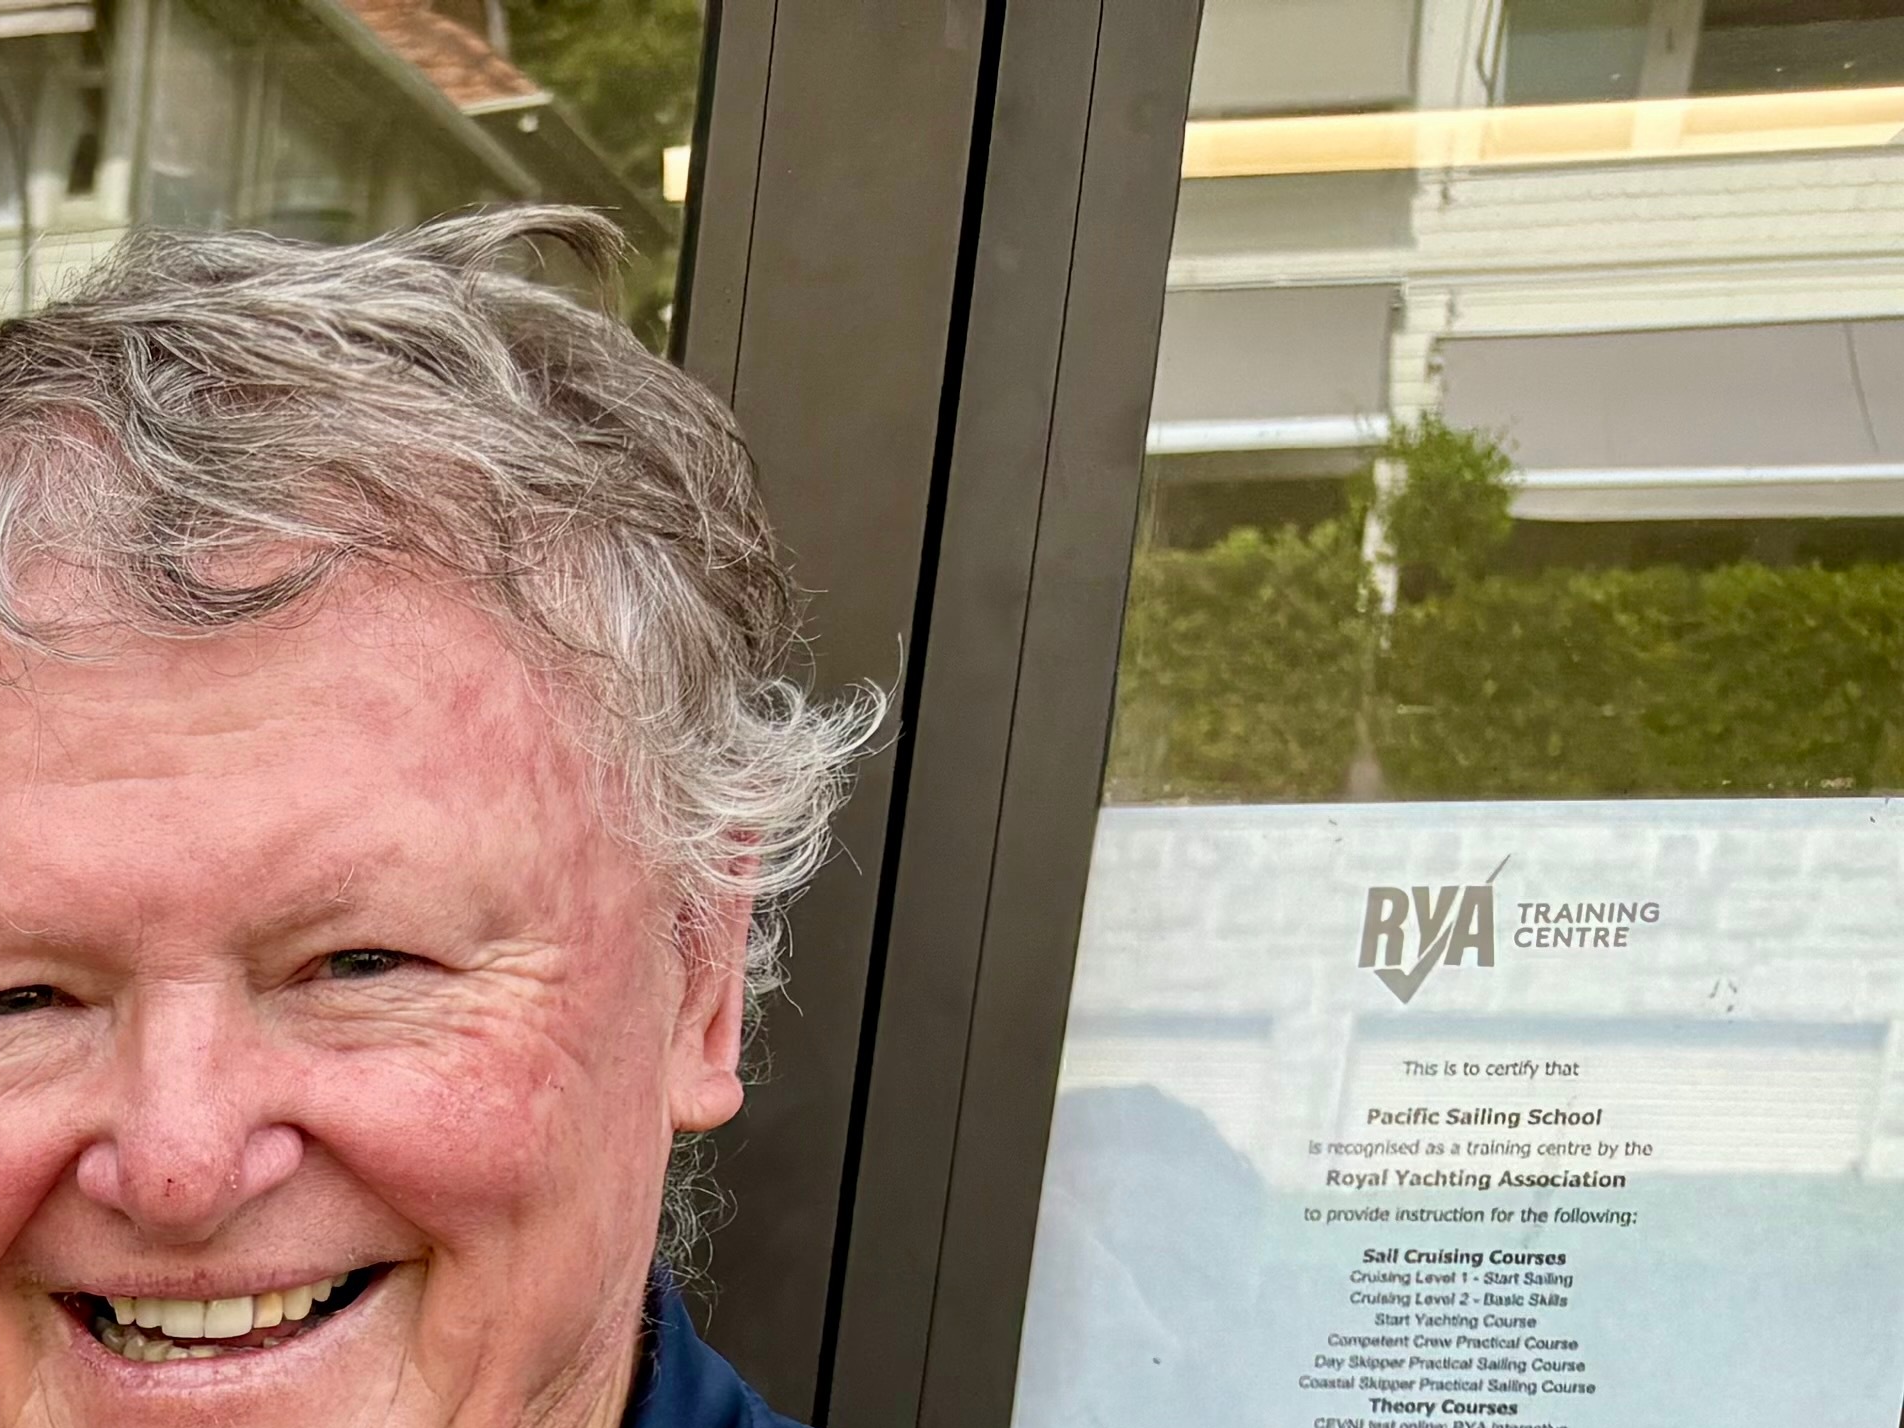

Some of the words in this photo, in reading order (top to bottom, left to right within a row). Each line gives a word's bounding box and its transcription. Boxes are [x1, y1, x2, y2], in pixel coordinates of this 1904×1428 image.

[1358, 868, 1502, 1000] RYA
[1517, 901, 1661, 926] TRAINING
[1513, 926, 1629, 949] CENTRE
[1402, 1060, 1438, 1077] This
[1444, 1060, 1457, 1077] is
[1463, 1062, 1480, 1077] to
[1485, 1060, 1539, 1080] certify
[1545, 1060, 1581, 1077] that
[1366, 1107, 1440, 1126] Pacific
[1445, 1107, 1522, 1130] Sailing
[1527, 1107, 1603, 1127] School
[1308, 1139, 1322, 1155] is
[1327, 1138, 1420, 1159] recognised
[1424, 1143, 1446, 1156] as
[1450, 1144, 1461, 1156] a
[1466, 1140, 1532, 1160] training
[1536, 1141, 1593, 1157] centre
[1596, 1141, 1619, 1160] by
[1624, 1140, 1654, 1157] the
[1325, 1168, 1389, 1191] Royal
[1394, 1168, 1492, 1192] Yachting
[1497, 1169, 1628, 1189] Association
[1304, 1206, 1322, 1222] to
[1325, 1205, 1390, 1226] provide
[1394, 1206, 1485, 1224] instruction
[1490, 1206, 1515, 1224] for
[1520, 1206, 1549, 1224] the
[1553, 1206, 1639, 1228] following:
[1362, 1248, 1398, 1265] Sail
[1403, 1248, 1484, 1268] Cruising
[1489, 1249, 1567, 1266] Courses
[1349, 1269, 1411, 1287] Cruising
[1415, 1269, 1456, 1285] Level
[1460, 1270, 1468, 1285] 1
[1483, 1271, 1519, 1285] Start
[1523, 1271, 1574, 1288] Sailing
[1349, 1290, 1411, 1308] Cruising
[1415, 1291, 1455, 1306] Level
[1459, 1292, 1470, 1306] 2
[1483, 1292, 1524, 1307] Basic
[1527, 1292, 1569, 1308] Skills
[1374, 1312, 1410, 1327] Start
[1415, 1313, 1479, 1330] Yachting
[1483, 1313, 1538, 1328] Course
[1327, 1333, 1410, 1351] Competent
[1413, 1334, 1452, 1349] Crew
[1455, 1335, 1521, 1350] Practical
[1523, 1336, 1580, 1351] Course
[1313, 1354, 1345, 1372] Day
[1348, 1354, 1406, 1373] Skipper
[1408, 1356, 1473, 1371] Practical
[1476, 1357, 1528, 1374] Sailing
[1531, 1358, 1587, 1373] Course
[1297, 1375, 1355, 1390] Coastal
[1358, 1376, 1416, 1394] Skipper
[1418, 1377, 1484, 1392] Practical
[1487, 1378, 1539, 1396] Sailing
[1541, 1380, 1598, 1396] Course
[1369, 1397, 1437, 1418] Theory
[1442, 1399, 1519, 1416] Courses
